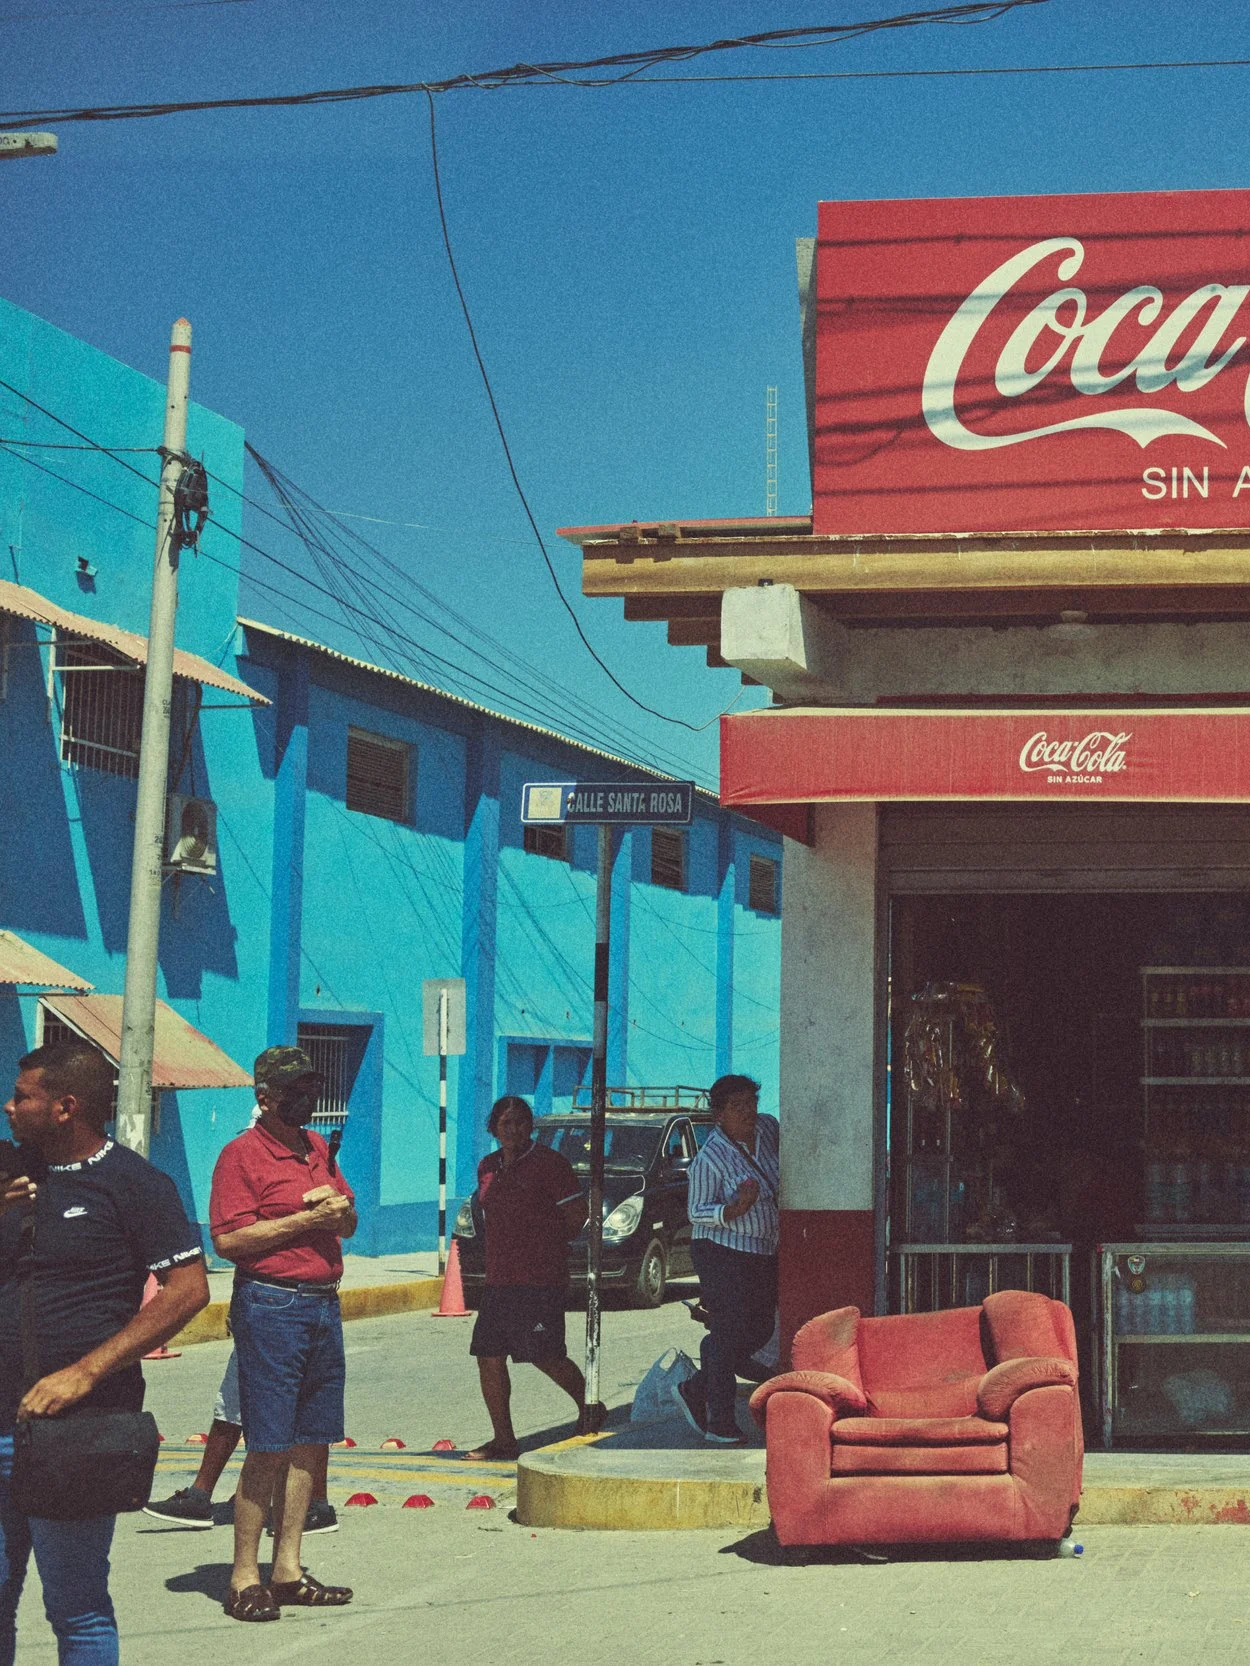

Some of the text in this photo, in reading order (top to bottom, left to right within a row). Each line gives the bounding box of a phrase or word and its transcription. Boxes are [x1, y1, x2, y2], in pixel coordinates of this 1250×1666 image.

[1140, 466, 1209, 500] SIN
[1019, 731, 1133, 772] Coca-Cola
[1047, 774, 1103, 784] SIN AZÚCAR
[567, 791, 682, 813] CALLE SANTA ROSA
[48, 1162, 82, 1172] NIKE
